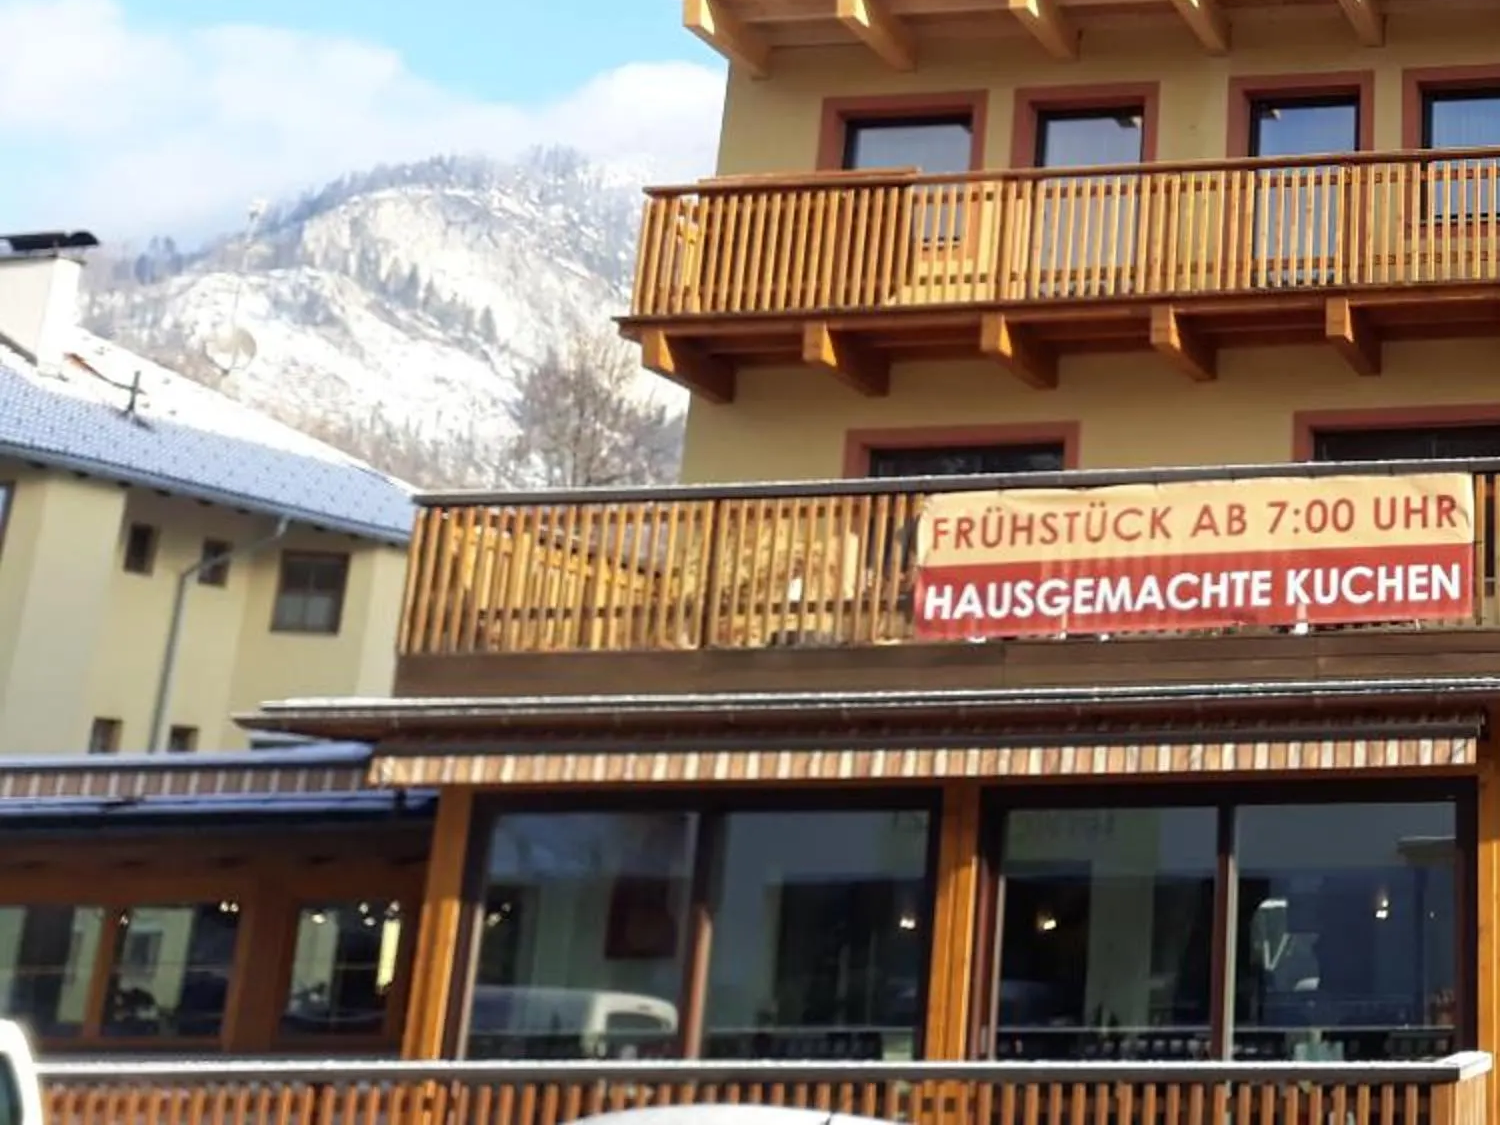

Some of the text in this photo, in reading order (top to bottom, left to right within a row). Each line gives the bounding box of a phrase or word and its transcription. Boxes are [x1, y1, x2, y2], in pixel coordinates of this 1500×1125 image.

[931, 494, 1458, 551] FRÜHSTÜCK AB 7:00 UHR
[923, 563, 1461, 621] HAUSGEMACHTE KUCHEN
